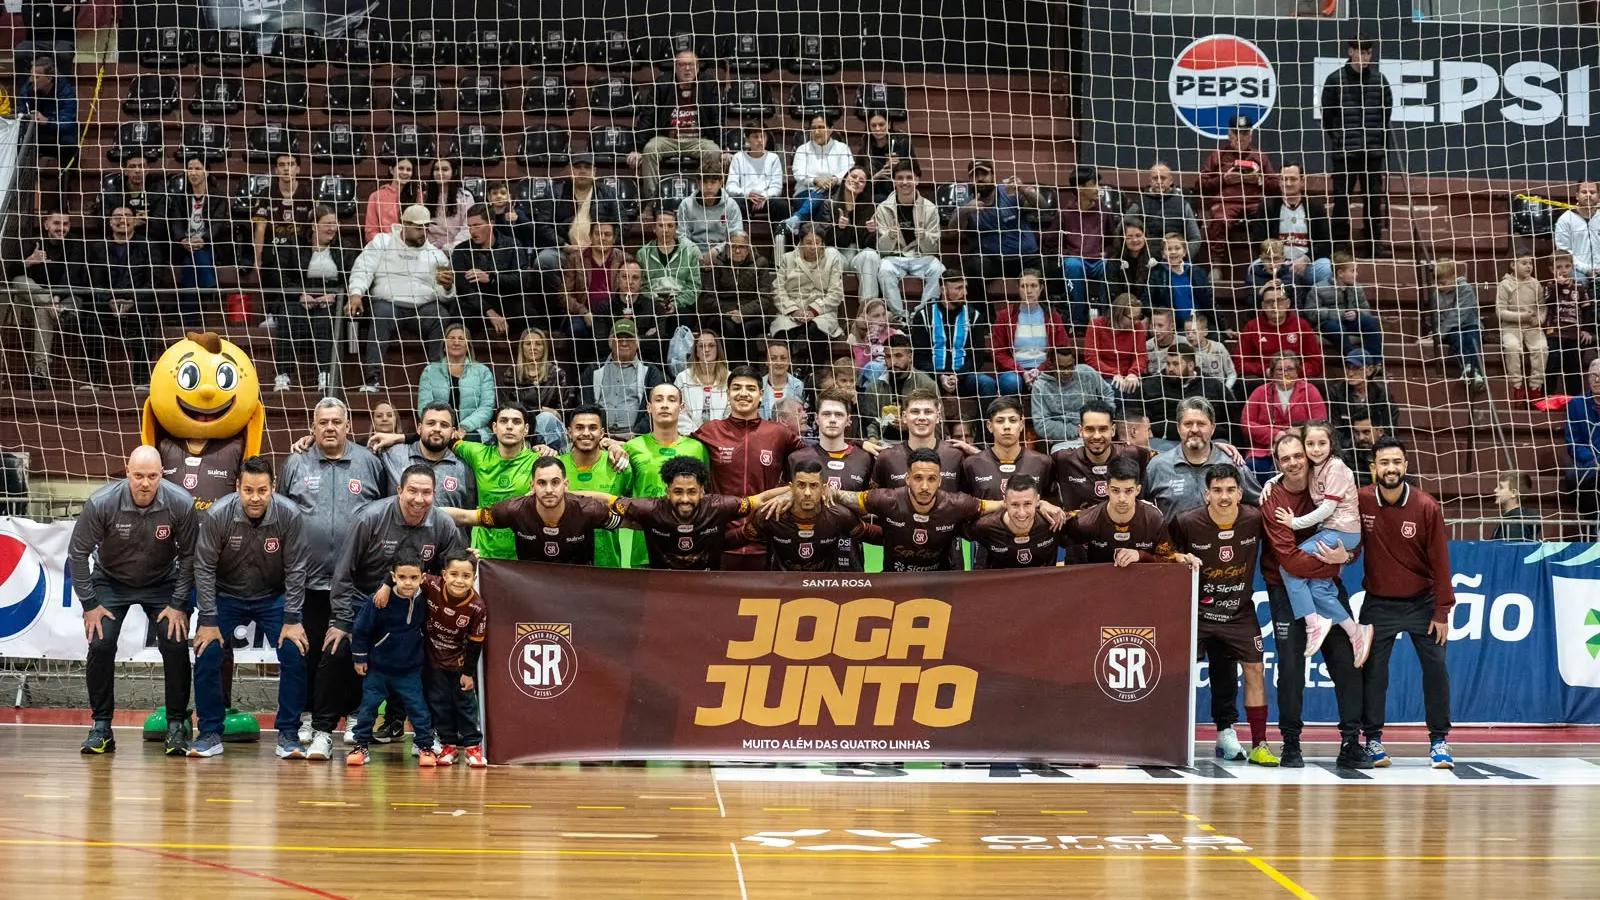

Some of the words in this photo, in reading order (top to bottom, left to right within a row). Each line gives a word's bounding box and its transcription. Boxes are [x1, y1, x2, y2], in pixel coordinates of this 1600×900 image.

[1176, 75, 1270, 99] PEPSI
[1404, 526, 1413, 535] SR
[916, 533, 925, 542] SR
[267, 542, 276, 550] SR
[547, 545, 556, 554] SR
[801, 547, 810, 556] SR
[1222, 550, 1231, 559] SR
[802, 579, 840, 588] SANTA
[841, 579, 872, 588] ROSA
[1216, 582, 1245, 593] Sicredi
[1216, 598, 1241, 608] pepsi
[725, 598, 952, 660] JOGA
[528, 633, 544, 641] SANTA
[545, 633, 560, 642] ROSA
[1112, 636, 1129, 645] SANTA
[1130, 636, 1144, 645] ROSA
[523, 644, 562, 685] SR
[1108, 647, 1147, 689] SR
[694, 665, 979, 727] JUNTO
[742, 740, 780, 749] MUITO
[781, 737, 813, 749] ALÉM
[815, 740, 839, 749] DAS
[840, 740, 887, 750] QUATRO
[889, 740, 930, 749] LINHAS
